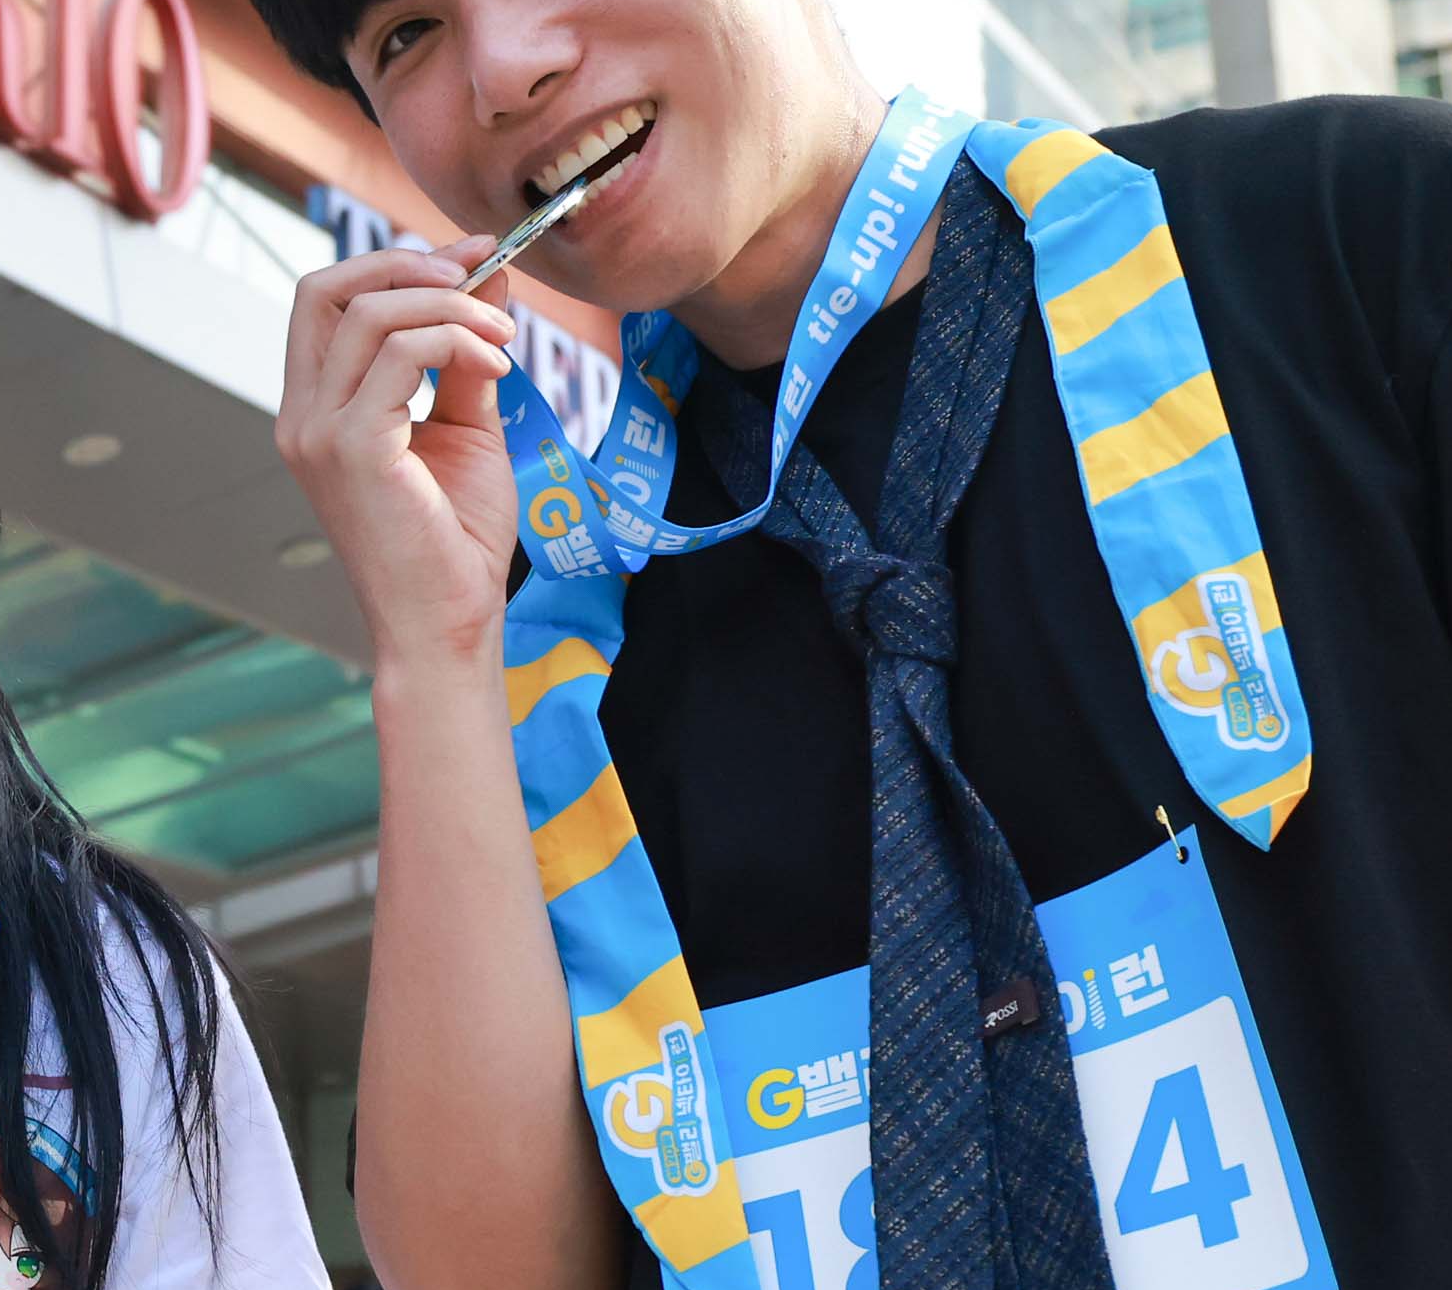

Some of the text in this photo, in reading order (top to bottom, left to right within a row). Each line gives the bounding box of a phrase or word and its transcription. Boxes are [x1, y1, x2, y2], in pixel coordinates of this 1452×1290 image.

[808, 188, 905, 345] tie-up!
[1211, 584, 1239, 605] 런
[1218, 606, 1252, 671] 넥타이
[1109, 944, 1169, 1018] 런
[668, 1034, 708, 1184] G밸리 넥타이 런
